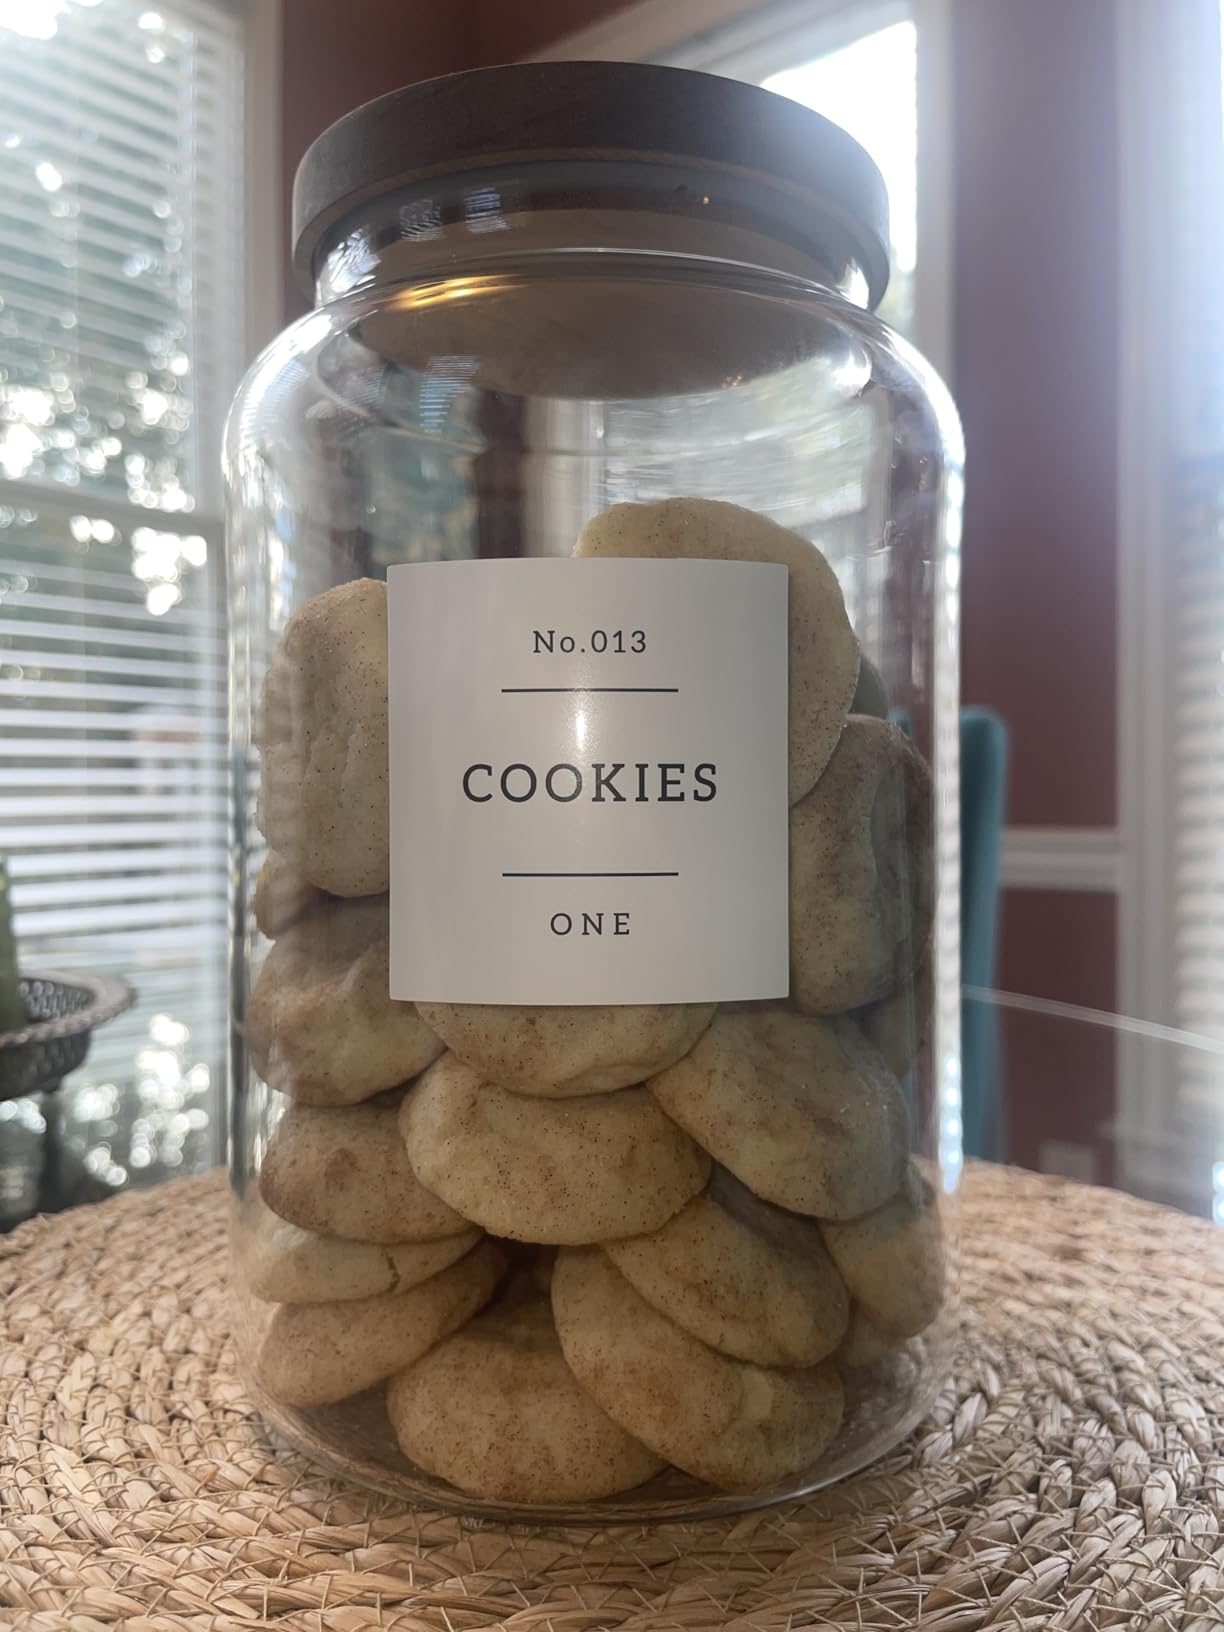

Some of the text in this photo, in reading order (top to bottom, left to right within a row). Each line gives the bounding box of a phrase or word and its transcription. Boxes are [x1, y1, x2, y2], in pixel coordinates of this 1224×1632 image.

[532, 629, 648, 655] No.013
[462, 762, 718, 803] COOKIES
[550, 912, 631, 936] ONE
